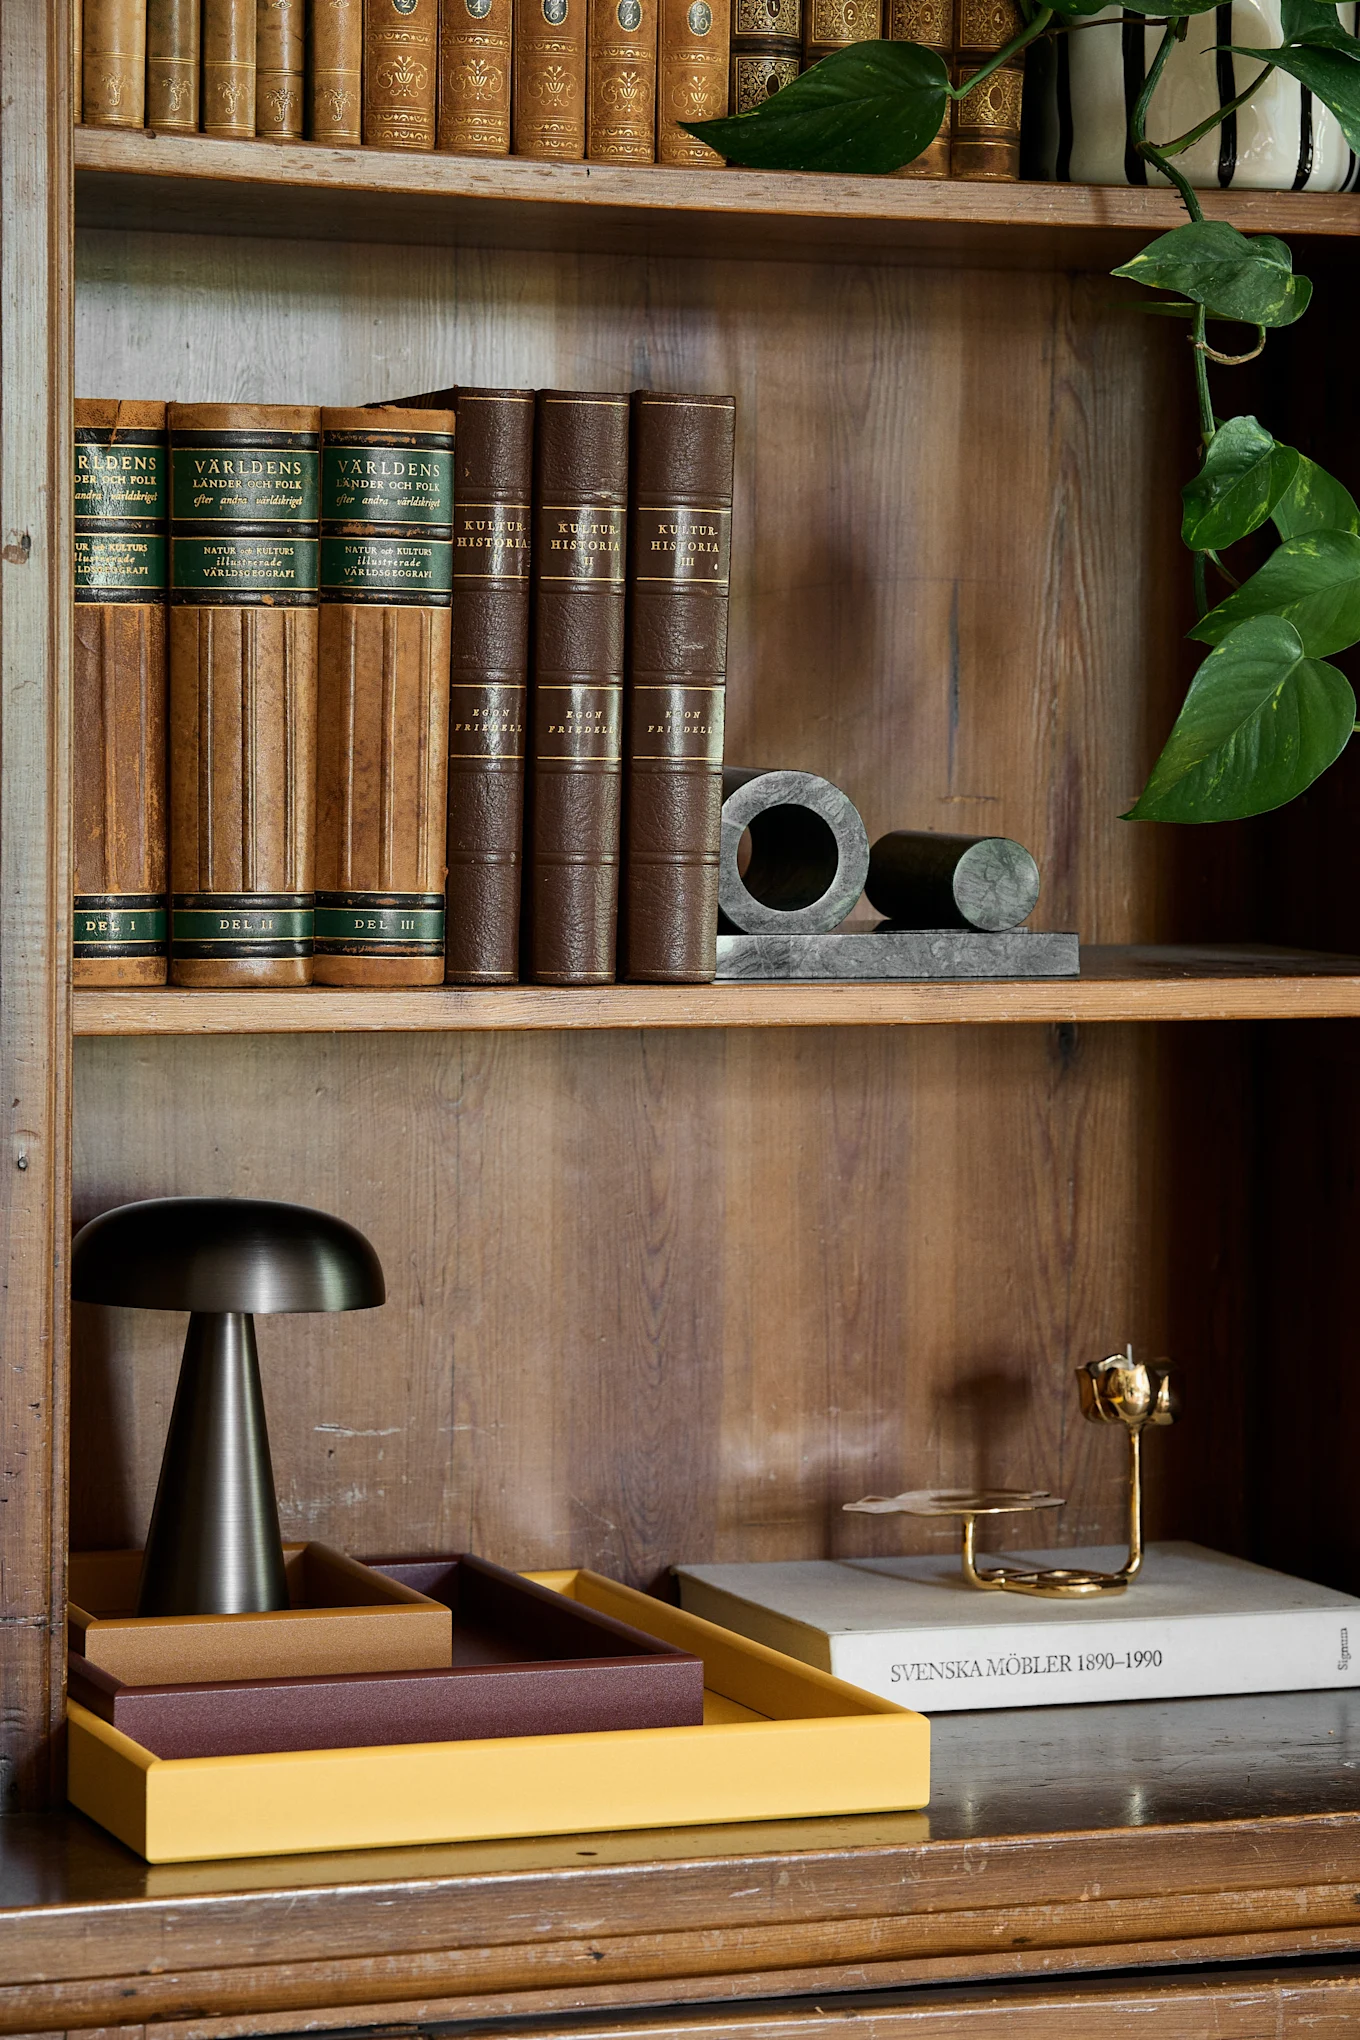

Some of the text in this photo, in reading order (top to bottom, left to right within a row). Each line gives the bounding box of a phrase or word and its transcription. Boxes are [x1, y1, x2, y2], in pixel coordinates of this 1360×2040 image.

[471, 0, 483, 13] 4
[625, 0, 635, 14] 7
[771, 0, 779, 12] 1.
[625, 14, 633, 26] 8
[847, 9, 857, 21] 2.
[924, 11, 934, 23] 3.
[994, 12, 1004, 24] 4.
[692, 17, 708, 31] 10
[194, 458, 302, 475] VÄRLDENS
[337, 459, 441, 478] VÄRLDENS
[102, 475, 126, 485] OCH
[130, 475, 157, 486] FOLK
[192, 477, 303, 490] LÄNDER OCH FOLK
[336, 477, 441, 492] LÄNDER OCH FOLK
[75, 489, 159, 505] andra världskriget
[193, 493, 304, 509] efter andra världskriget
[336, 493, 441, 511] efter andra världskriget
[464, 520, 527, 532] KULTUR-
[558, 523, 620, 535] KULTUR-
[658, 524, 719, 536] KULTUR-
[109, 543, 149, 553] KULTURS
[456, 536, 528, 549] HISTORIA
[550, 540, 620, 551] HISTORIA
[650, 540, 720, 553] HISTORIA
[203, 546, 295, 556] NATUR och KULTURS
[345, 545, 432, 556] NATUR och KULTURS
[216, 556, 282, 567] illustrerade
[357, 556, 421, 568] illustrerade
[584, 556, 595, 566] II
[680, 557, 695, 567] III
[74, 565, 149, 575] LDSGEOGRAFI
[202, 566, 295, 578] VÄRLDSGEOGRAFI
[343, 565, 433, 579] VÄRLDSGEOGRAFI
[472, 708, 510, 717] EGON
[565, 710, 603, 719] EGON
[454, 723, 523, 732] FRIEDELL
[548, 725, 615, 734] FRIEDELL
[85, 920, 136, 931] DEL I
[219, 919, 273, 930] DEL II
[354, 919, 415, 930] DEL III
[1337, 1627, 1352, 1671] Signum
[890, 1658, 984, 1683] SVENSKA
[985, 1652, 1073, 1677] MÖBLER
